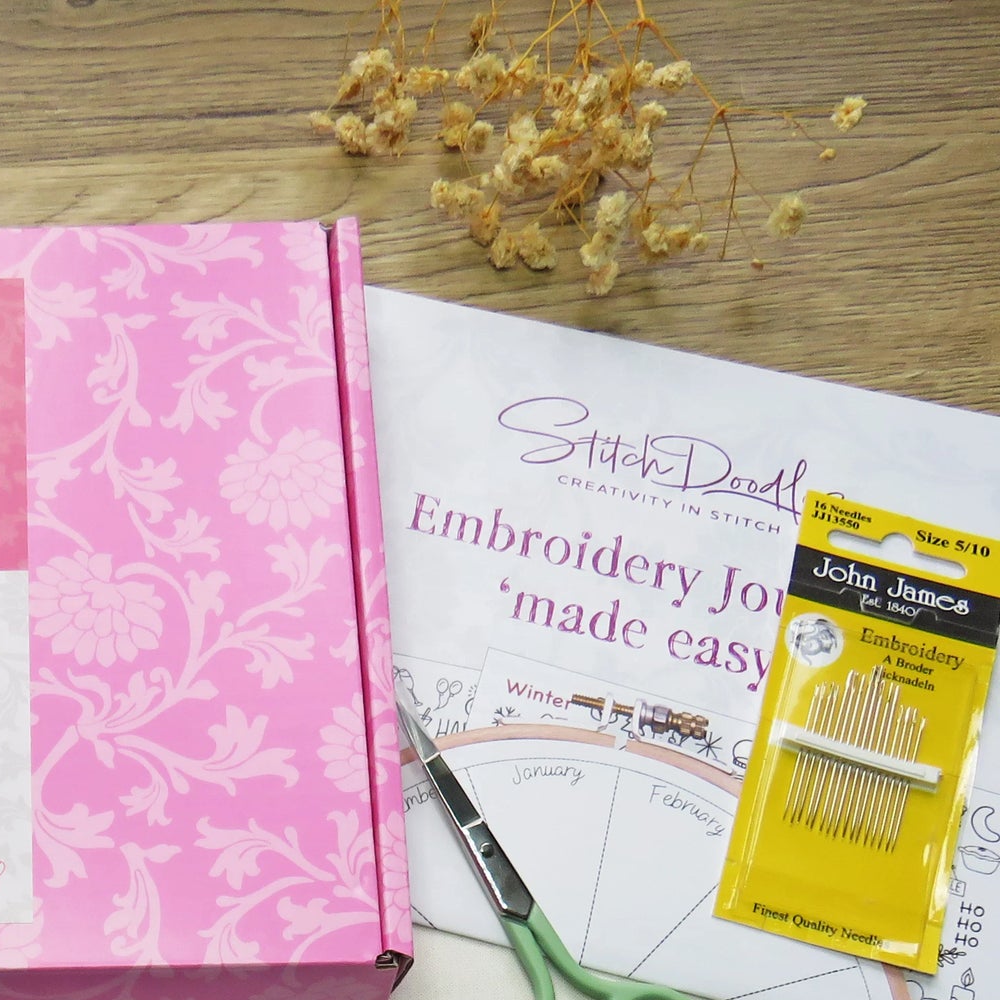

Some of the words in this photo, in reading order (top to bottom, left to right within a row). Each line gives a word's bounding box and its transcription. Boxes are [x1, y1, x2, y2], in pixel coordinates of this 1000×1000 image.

[498, 397, 808, 525] StitchDoodl
[557, 475, 672, 509] CREATIVITY
[682, 504, 700, 516] IN
[710, 510, 781, 534] STITCH
[814, 500, 827, 511] 16
[830, 502, 872, 523] Needles
[812, 510, 860, 530] JJ13550
[405, 492, 703, 608] Embroidery
[916, 529, 950, 548] Size
[955, 540, 991, 558] 5/10
[812, 557, 877, 592] John
[887, 576, 970, 616] James
[886, 601, 917, 617] 1840
[667, 628, 772, 692] easy
[860, 627, 965, 670] Embroidery
[873, 667, 936, 692] icknadeln
[882, 654, 892, 664] A
[896, 657, 935, 676] Broder
[506, 679, 572, 710] Winter
[512, 765, 585, 785] January
[649, 784, 725, 836] February
[752, 902, 788, 922] Finest
[792, 914, 838, 937] Quality
[960, 901, 985, 917] HO
[955, 932, 979, 947] HO
[957, 917, 982, 933] HO
